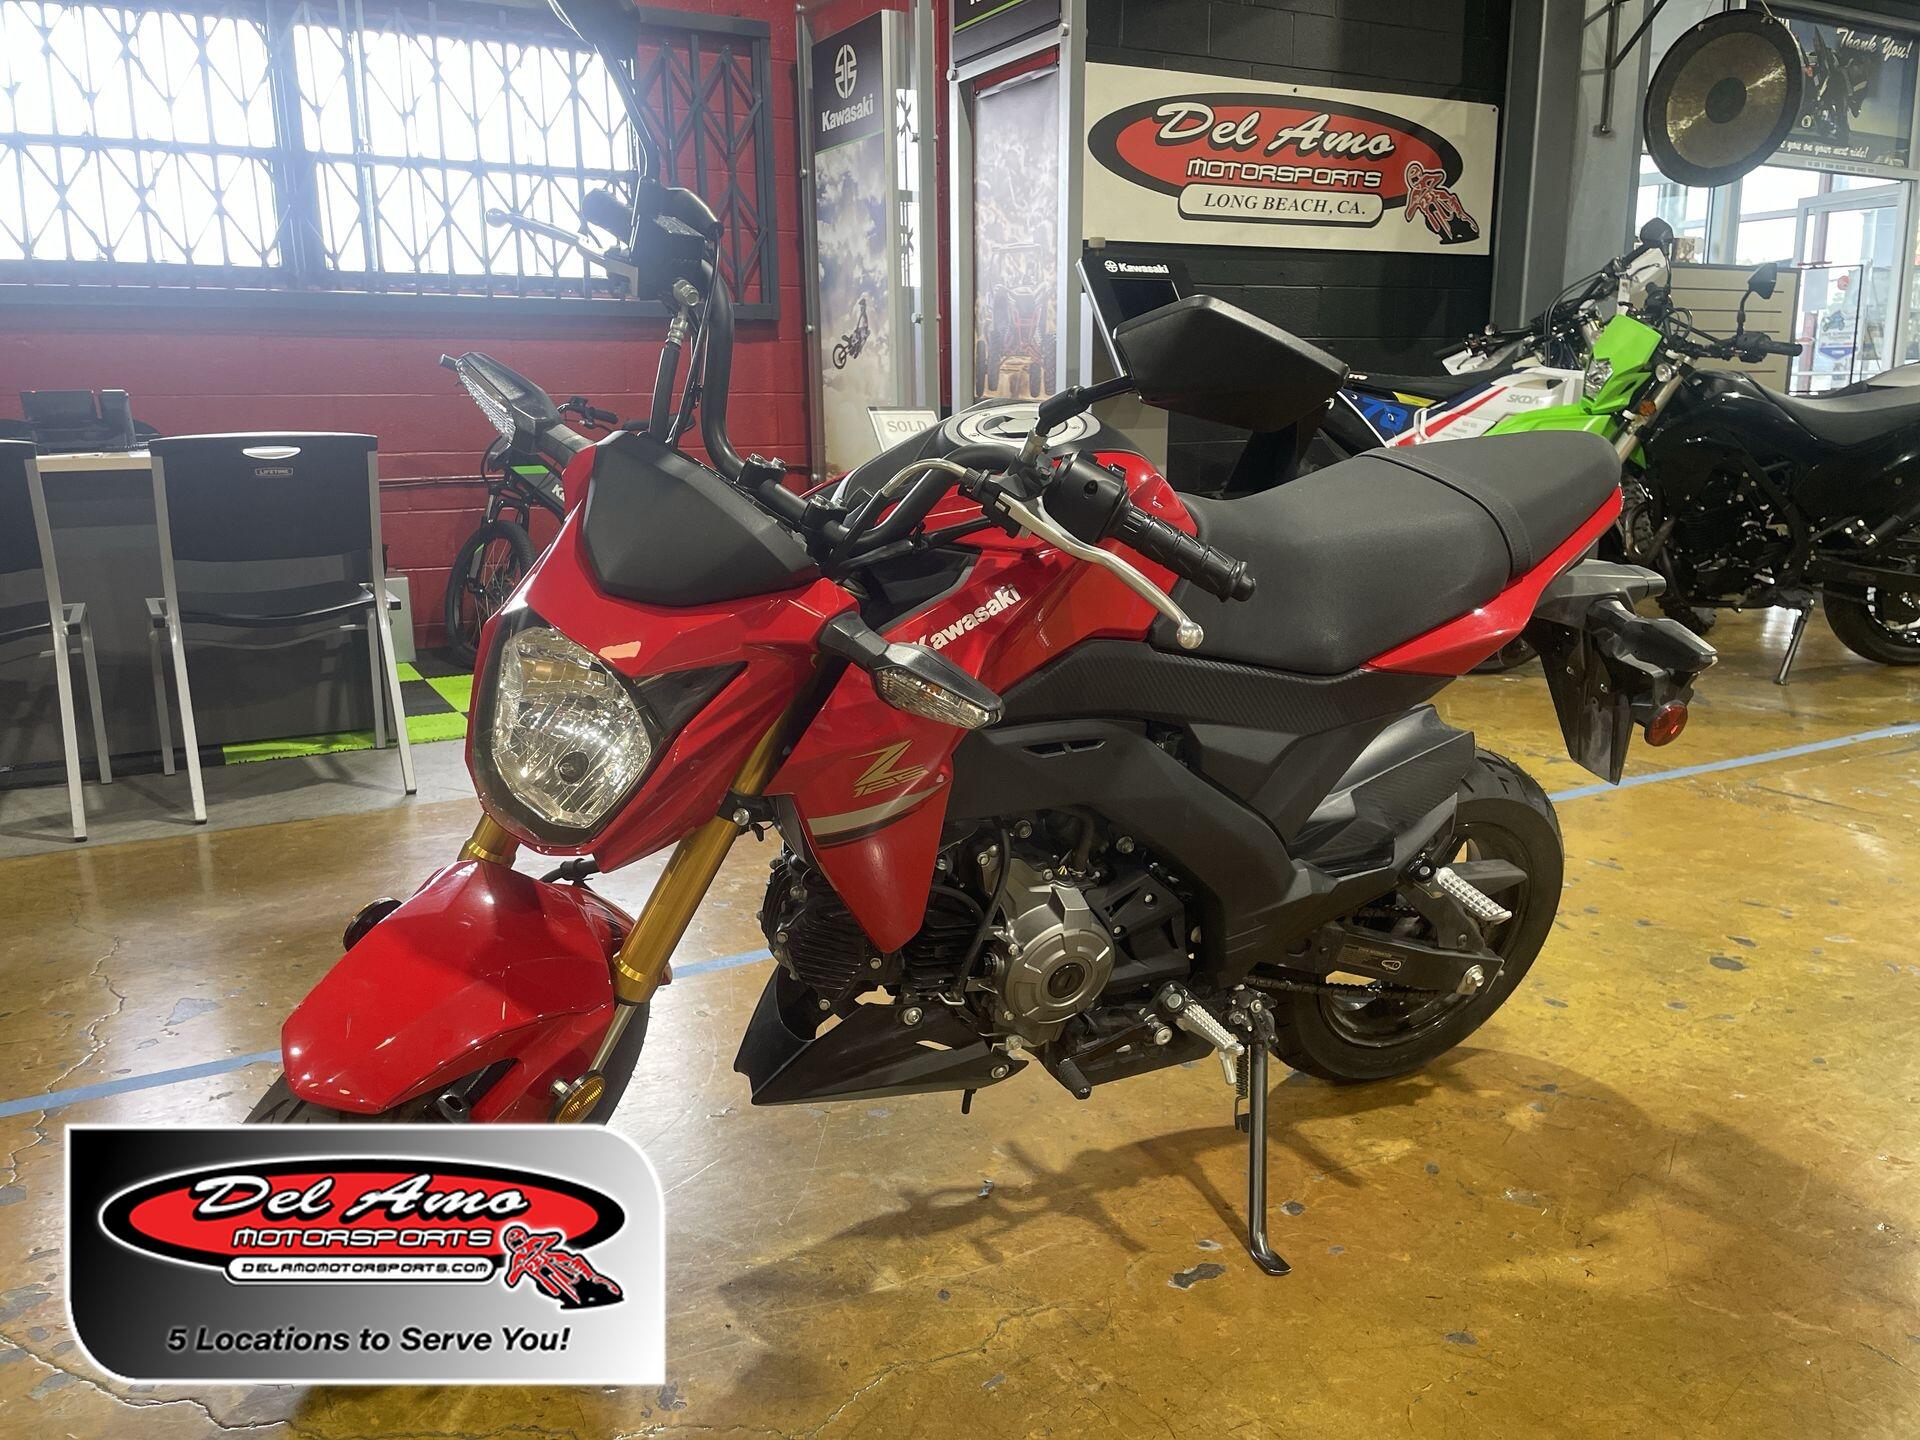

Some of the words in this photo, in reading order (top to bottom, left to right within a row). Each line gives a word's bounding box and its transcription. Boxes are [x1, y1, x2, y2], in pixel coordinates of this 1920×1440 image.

[1836, 27, 1877, 53] Thank
[1882, 35, 1914, 62] You!
[821, 93, 874, 132] Kawasaki
[1156, 102, 1261, 147] Del
[1267, 113, 1396, 157] Amo
[1187, 157, 1382, 188] MOTORSPORTS
[1204, 193, 1257, 210] LONG
[1263, 196, 1334, 215] BEACH,
[1337, 200, 1366, 215] CA.
[1118, 262, 1169, 274] Kawasaki
[887, 420, 927, 433] SOLD
